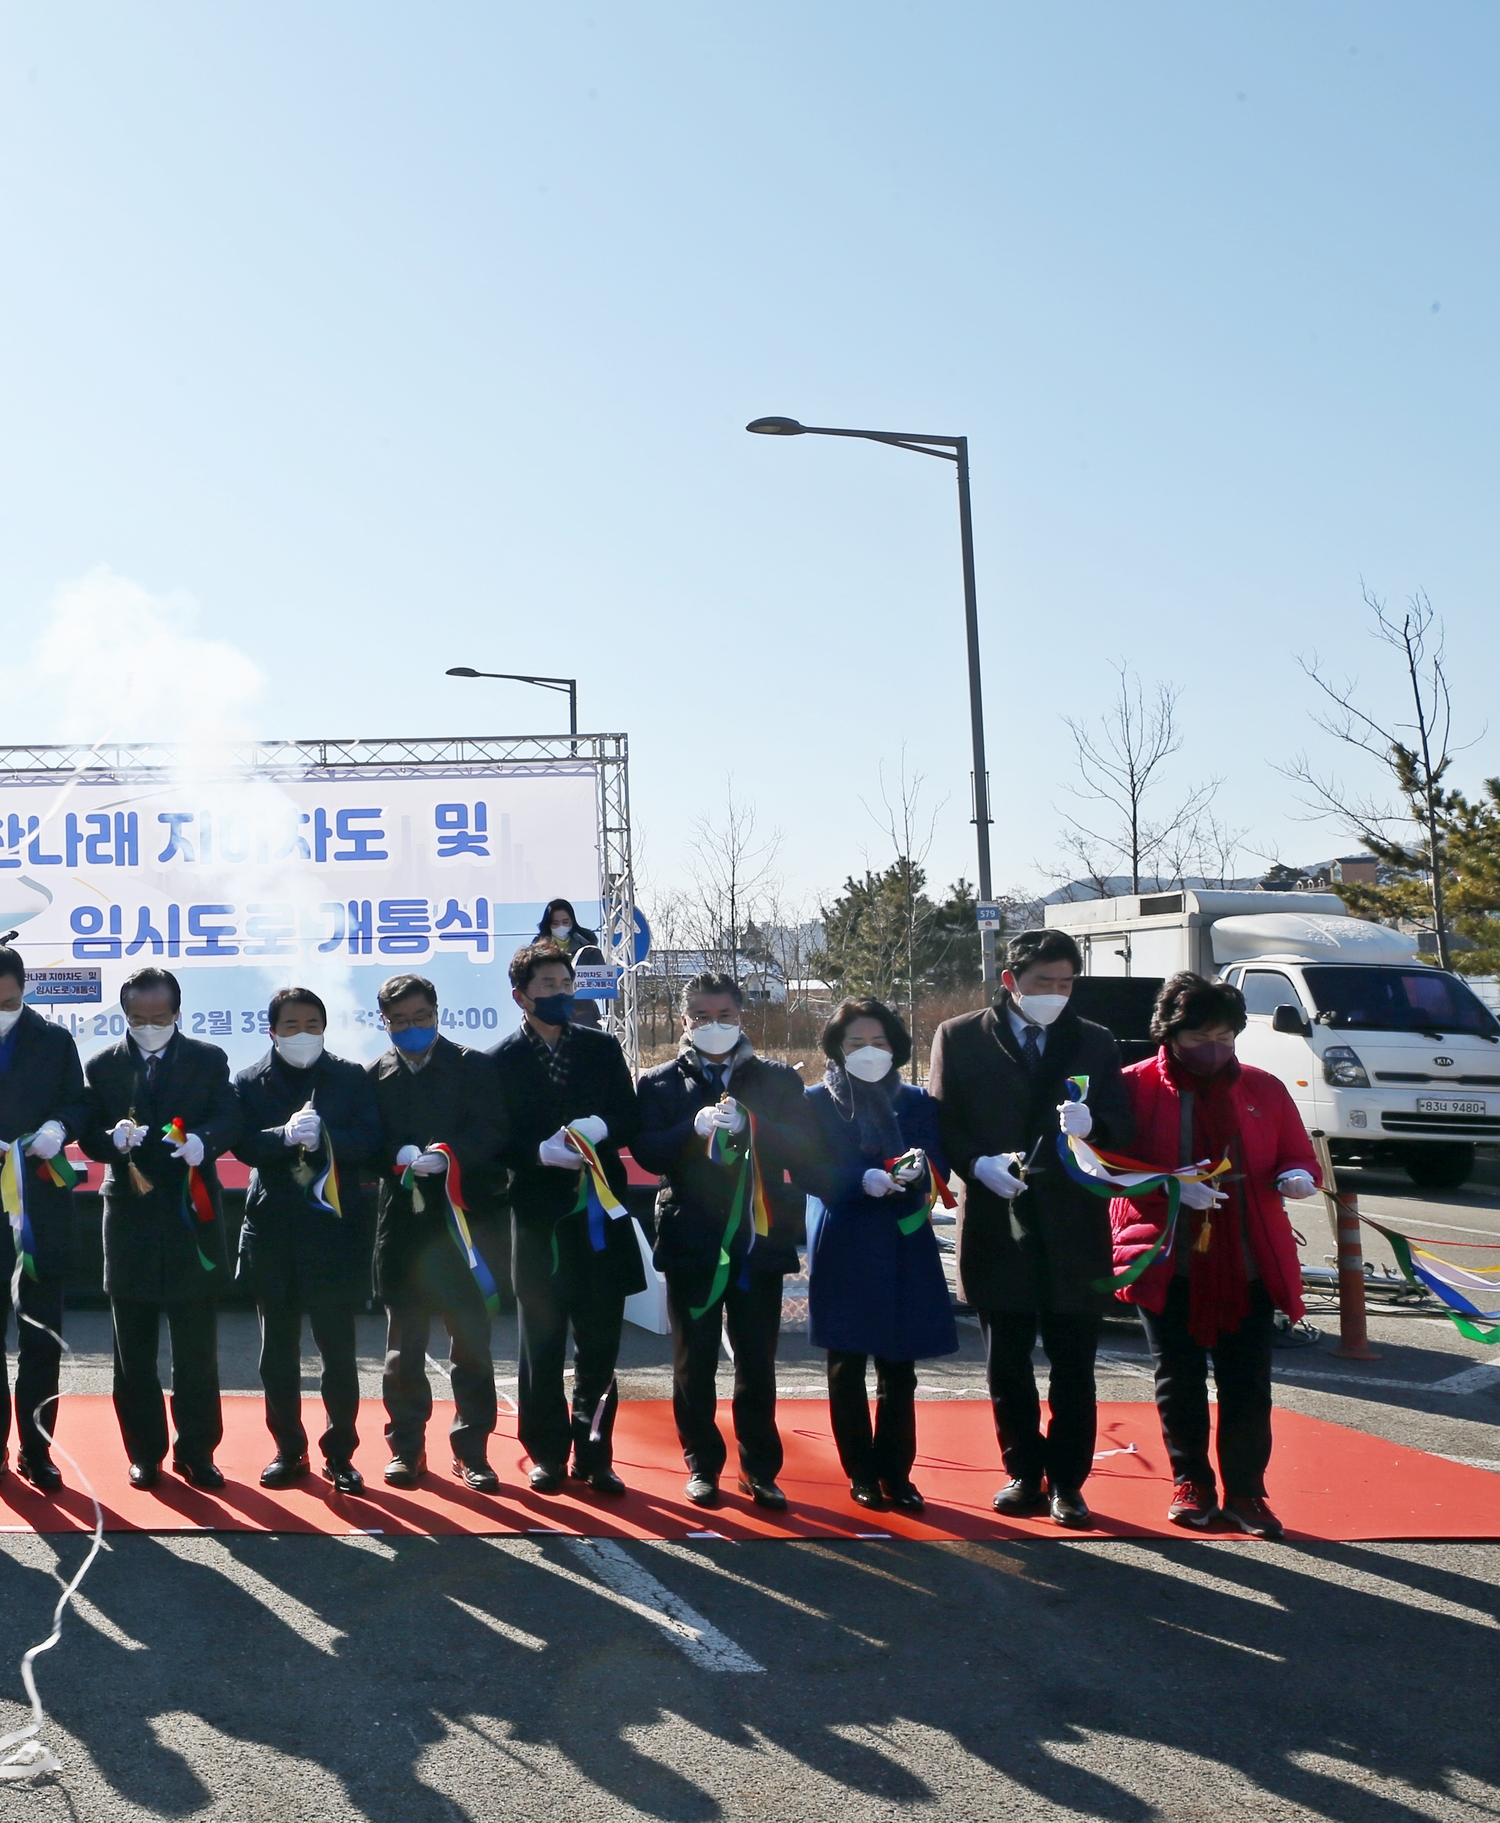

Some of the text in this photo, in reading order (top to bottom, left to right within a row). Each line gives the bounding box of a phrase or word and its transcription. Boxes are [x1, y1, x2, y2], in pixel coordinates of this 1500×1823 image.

[157, 807, 389, 865] 지하차도
[434, 801, 491, 858] 및
[980, 910, 996, 918] 579
[70, 896, 489, 960] 임시도로 개통식
[36, 985, 70, 995] 임시도로
[191, 1010, 233, 1036] 2월
[440, 1007, 498, 1030] 4:00
[1452, 1102, 1479, 1113] 9480
